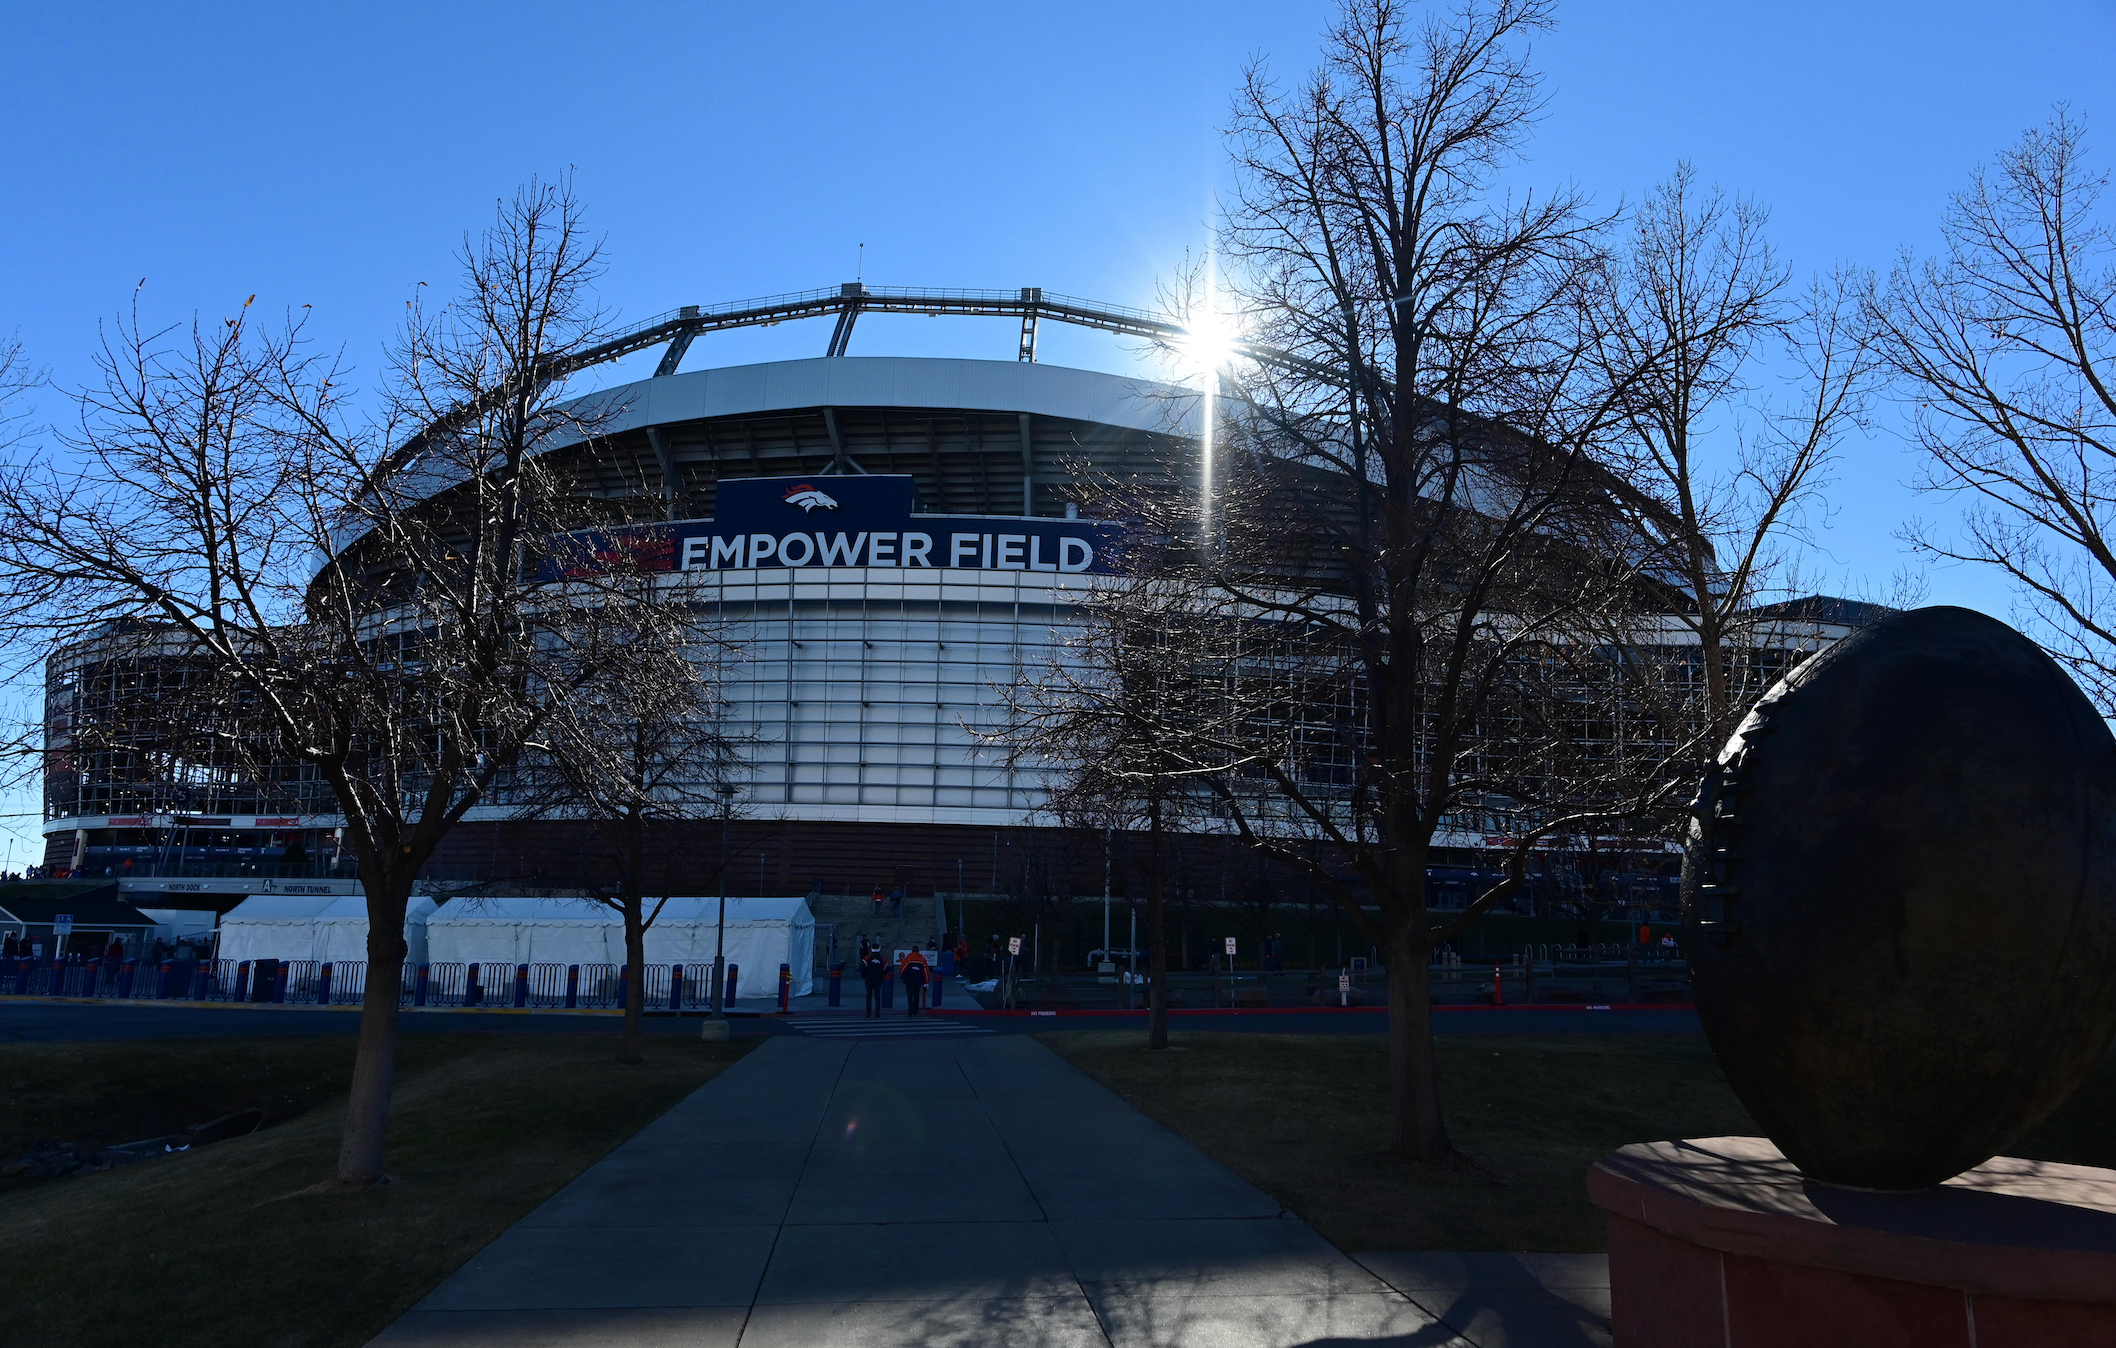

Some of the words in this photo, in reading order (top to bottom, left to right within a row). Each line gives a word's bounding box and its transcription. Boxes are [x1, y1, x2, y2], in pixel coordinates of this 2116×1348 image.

[681, 531, 933, 571] EMPOWER
[949, 533, 1093, 572] FIELD
[262, 880, 271, 892] A
[284, 885, 304, 893] NORTH
[307, 886, 331, 894] TUNNEL
